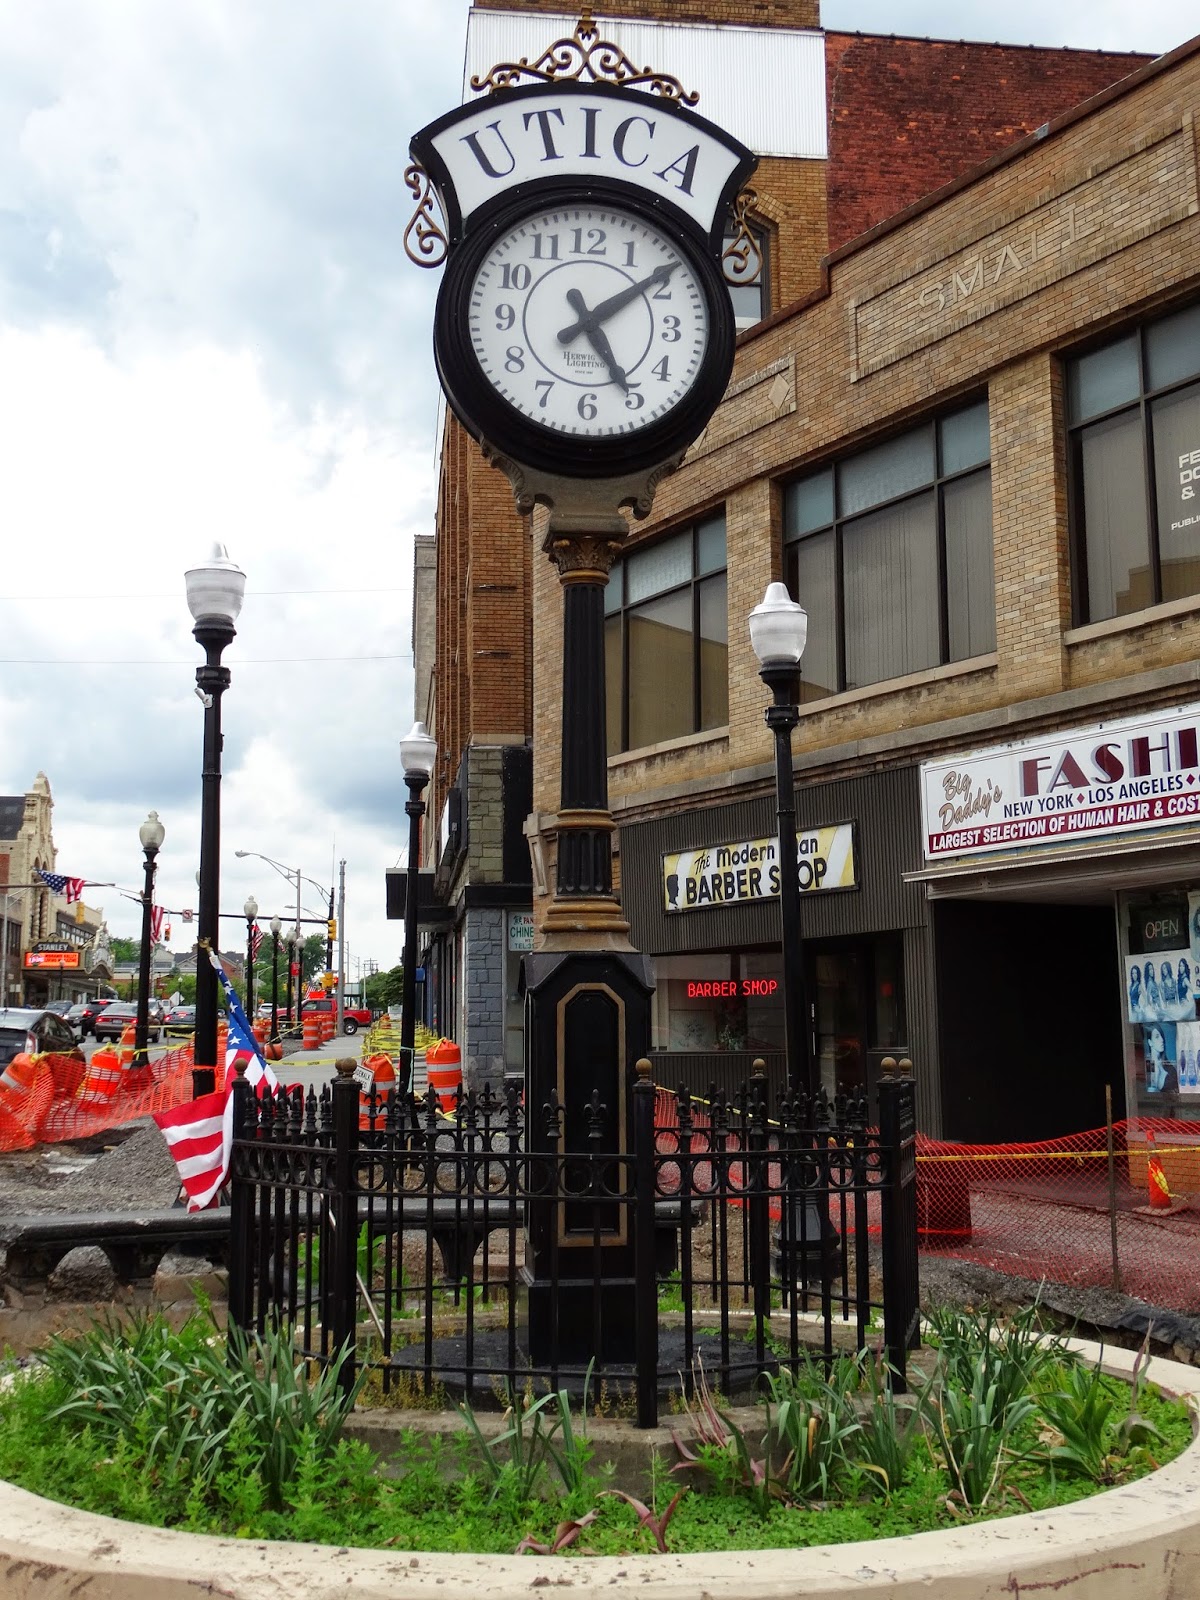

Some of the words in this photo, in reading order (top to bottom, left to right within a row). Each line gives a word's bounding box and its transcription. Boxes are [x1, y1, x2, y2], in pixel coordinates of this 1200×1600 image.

[459, 106, 703, 198] UTICA
[529, 232, 563, 261] 11
[569, 227, 607, 255] 12
[621, 240, 639, 268] 1
[497, 262, 532, 291] 10
[495, 303, 516, 331] 9
[661, 315, 682, 343] 3
[504, 346, 525, 374] 8
[563, 351, 596, 361] HERWIG
[566, 358, 605, 369] LIGHTING
[651, 355, 672, 383] 4
[534, 380, 556, 408] 7
[577, 393, 598, 421] 6
[625, 382, 645, 410] 5
[1181, 486, 1195, 500] &
[942, 770, 973, 801] Big
[1003, 799, 1033, 818] NEW
[1038, 793, 1074, 813] YORK
[1088, 786, 1114, 805] LOS
[1119, 774, 1184, 800] ANGELES
[938, 778, 1003, 832] Daddy's
[932, 829, 981, 851] LARGEST
[983, 818, 1047, 843] SELECTION
[1049, 816, 1065, 834] OF
[1068, 807, 1114, 830] HUMAN
[1117, 802, 1150, 822] HAIR
[1154, 800, 1164, 817] &
[694, 850, 711, 875] The
[796, 837, 818, 855] an
[685, 867, 762, 905] BARBER
[768, 857, 828, 894] SOP
[1145, 919, 1179, 939] OPEN
[37, 943, 69, 951] STANLEY
[687, 981, 737, 998] BARBER
[742, 979, 778, 996] SHOP
